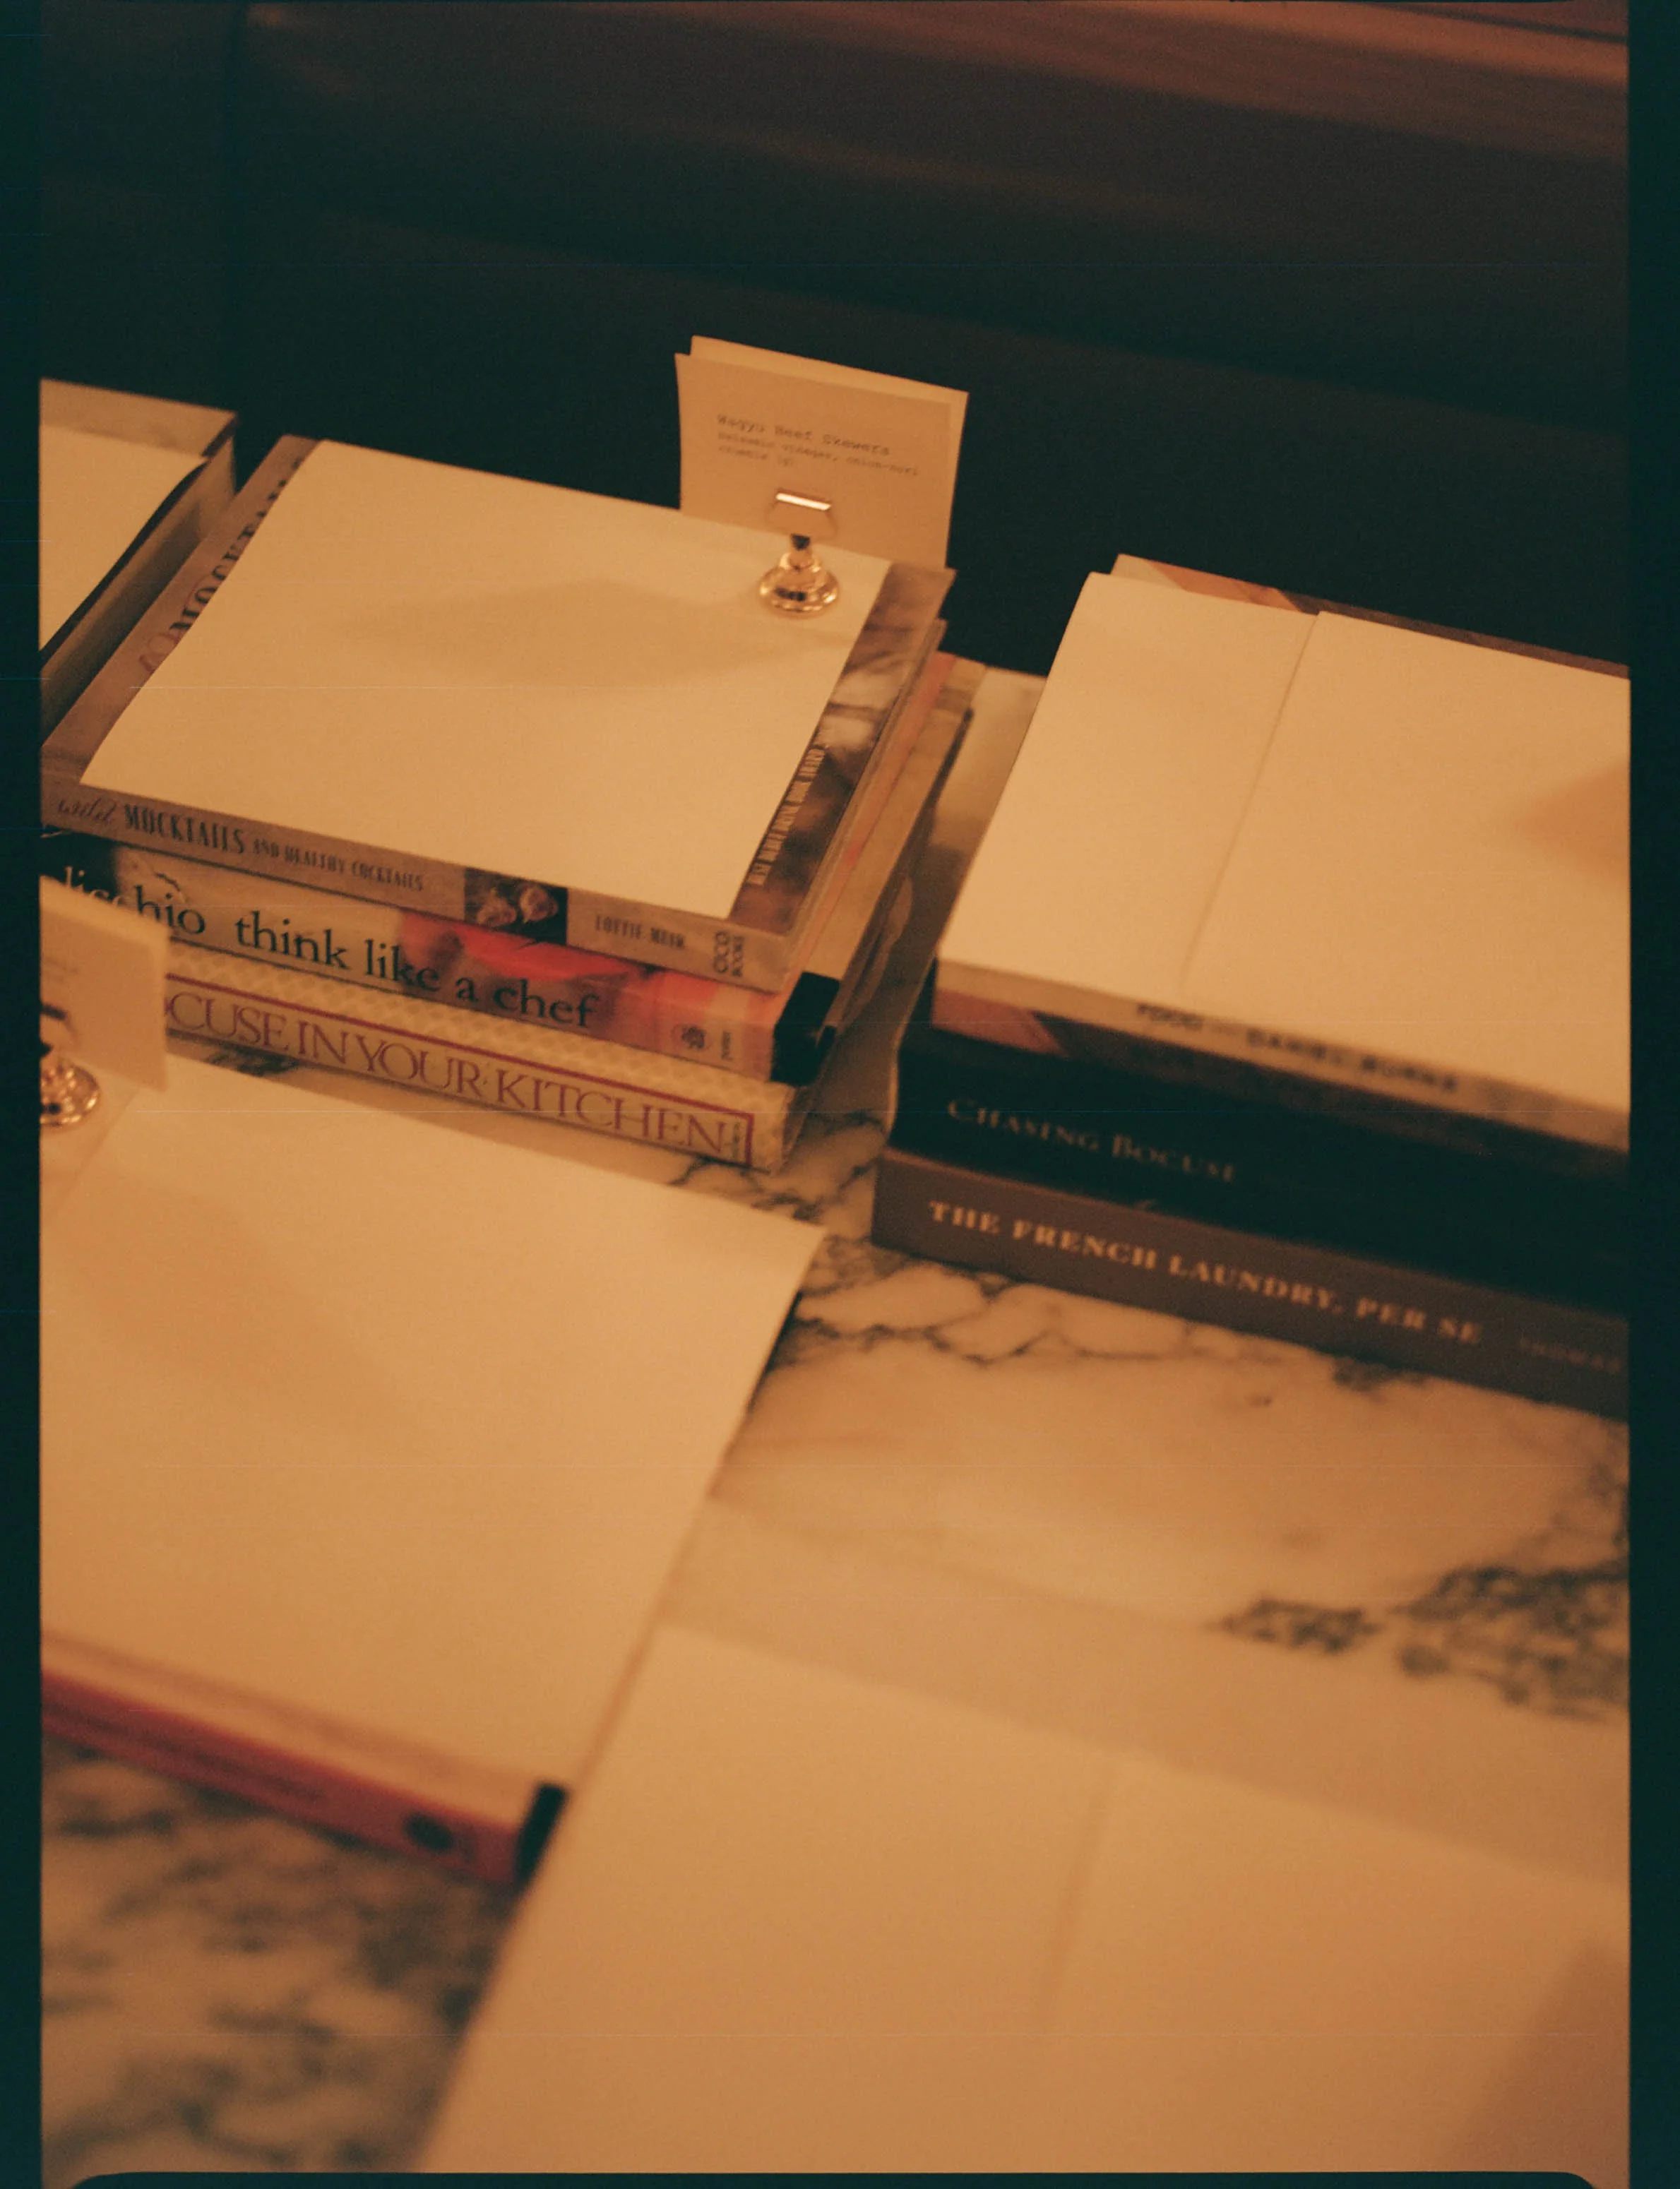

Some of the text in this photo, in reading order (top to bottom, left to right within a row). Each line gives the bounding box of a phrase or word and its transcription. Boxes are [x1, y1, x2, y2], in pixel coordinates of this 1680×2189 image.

[124, 803, 245, 854] MOCKTAILS
[352, 861, 424, 893] COCKTAILS
[236, 910, 350, 972] think
[366, 938, 441, 991] like
[456, 976, 479, 1003] a
[494, 978, 600, 1026] chef
[164, 991, 288, 1051] CUSE
[298, 1020, 347, 1065] IN
[355, 1034, 483, 1099] YOUR
[496, 1068, 726, 1155] KITCHEN
[928, 1200, 1001, 1234] THE
[1012, 1219, 1158, 1270] FRENCH
[1354, 1297, 1428, 1332] PER
[1437, 1317, 1483, 1344] SE
